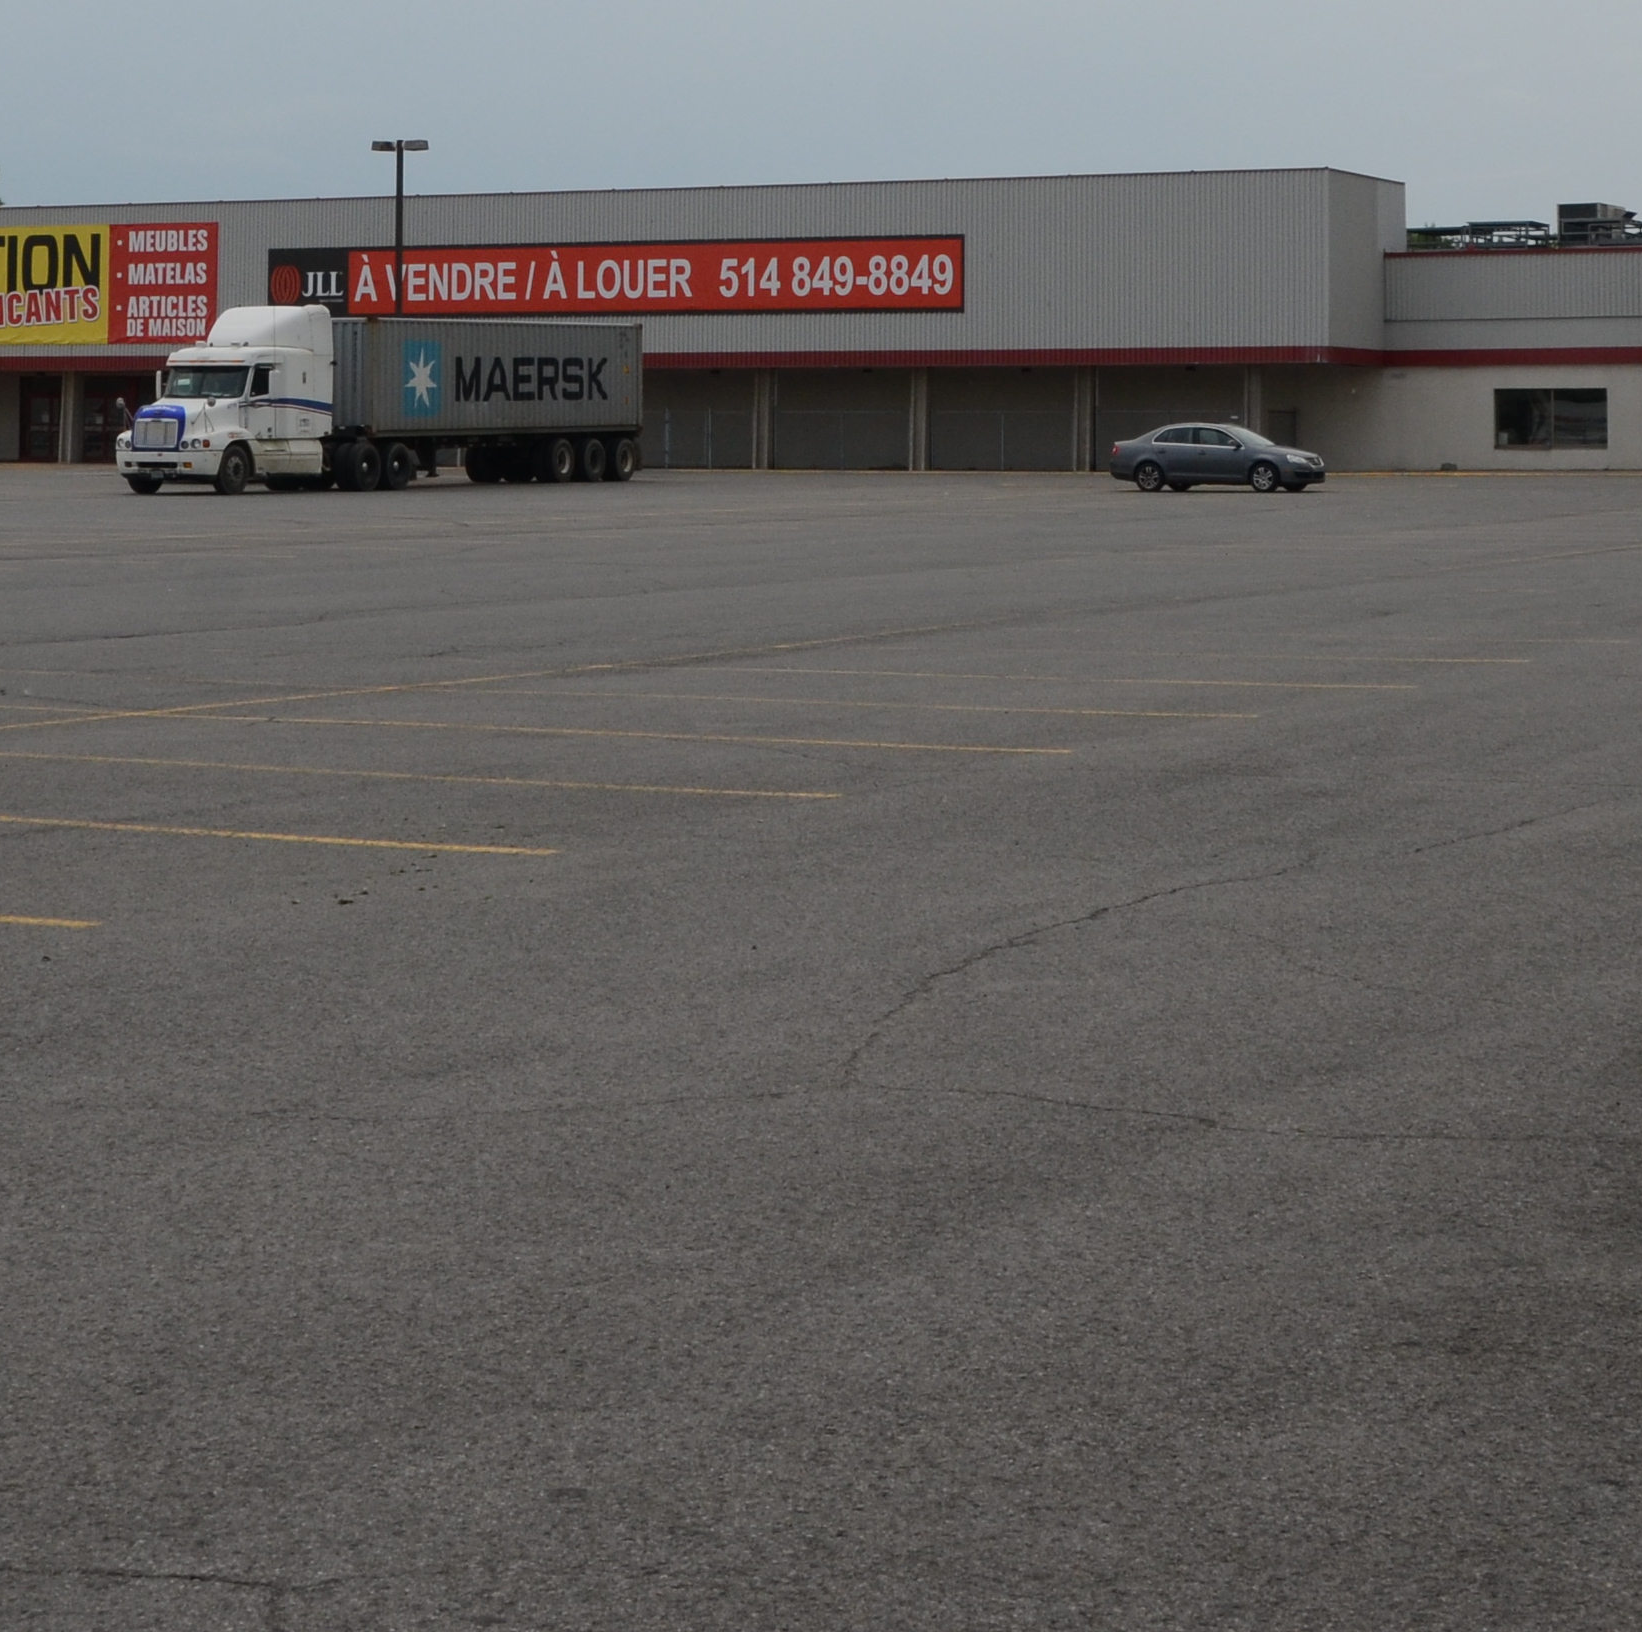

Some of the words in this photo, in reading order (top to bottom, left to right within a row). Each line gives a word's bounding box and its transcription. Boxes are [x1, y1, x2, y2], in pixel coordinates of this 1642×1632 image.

[128, 229, 208, 252] MEUBLES
[128, 262, 207, 285] MATELAS
[302, 271, 343, 297] JLL
[354, 254, 378, 302] À
[385, 262, 517, 302] VENDRE
[543, 250, 568, 301] À
[577, 259, 692, 300] LOUER
[719, 257, 780, 297] 514
[791, 254, 953, 296] 849-8849
[127, 295, 208, 317] ARTICLES
[127, 318, 144, 337] DE
[148, 318, 206, 337] MAISON
[455, 356, 608, 402] MAERSK
